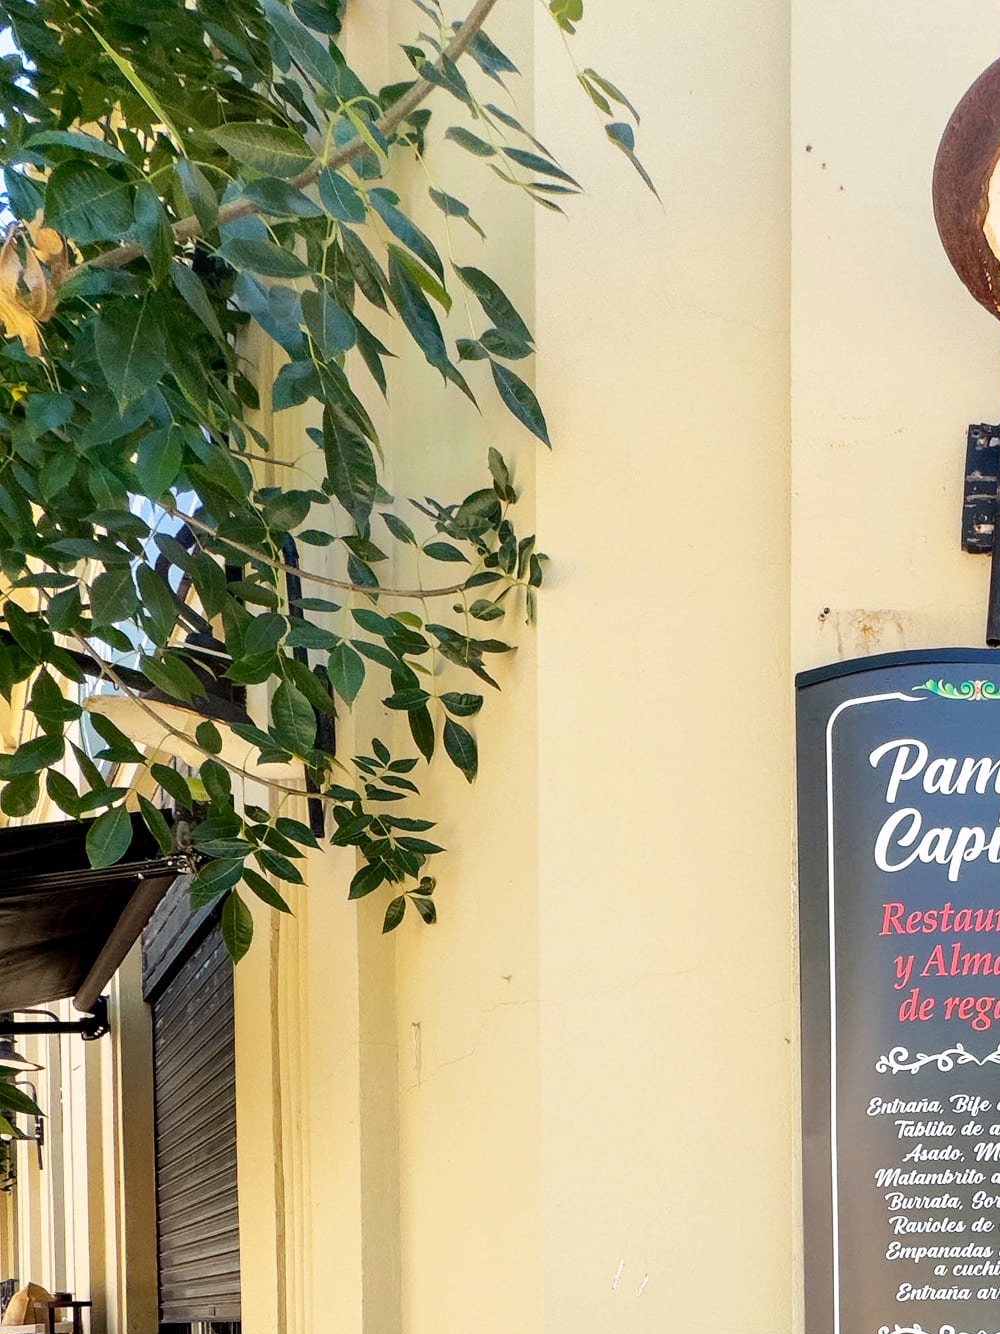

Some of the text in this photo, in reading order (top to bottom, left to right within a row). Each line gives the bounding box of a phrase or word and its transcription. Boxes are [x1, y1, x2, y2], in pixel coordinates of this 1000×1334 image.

[894, 955, 915, 988] y
[898, 988, 934, 1021] de
[867, 1097, 944, 1116] Entraña,
[949, 1094, 992, 1116] Bife
[894, 1121, 955, 1138] Tablita
[961, 1121, 984, 1136] de
[902, 1144, 965, 1162] Asado,
[874, 1169, 985, 1187] Matambrito
[885, 1192, 963, 1211] Burrata,
[889, 1216, 966, 1235] Ravioles
[971, 1216, 994, 1233] de
[886, 1242, 993, 1263] Empanadas
[934, 1265, 947, 1276] a
[896, 1284, 971, 1301] Entraña
